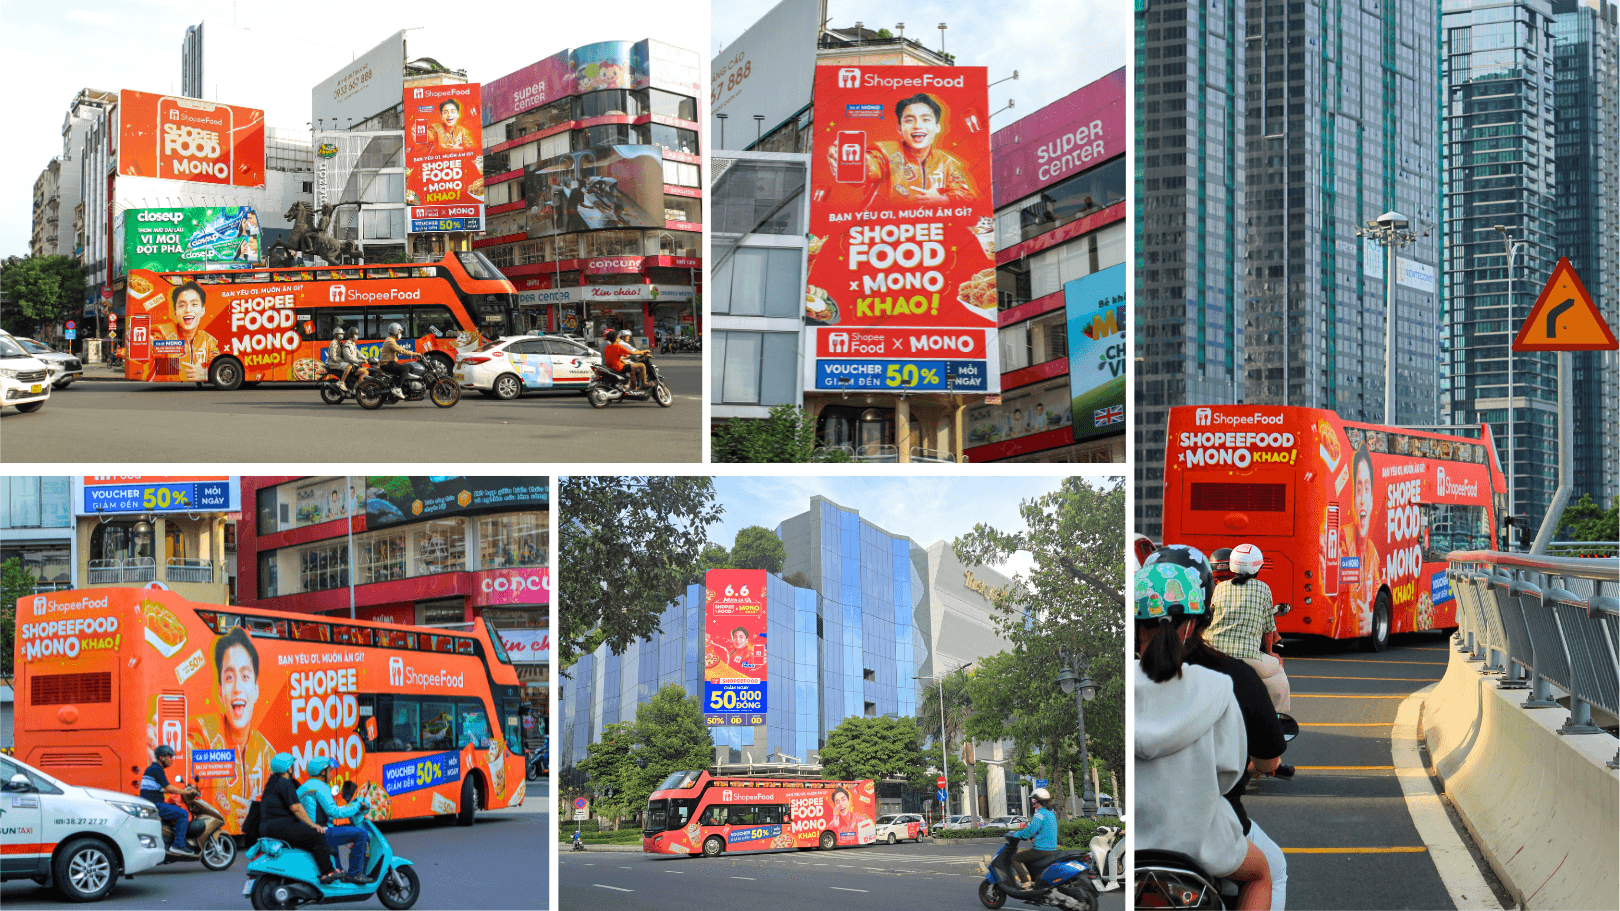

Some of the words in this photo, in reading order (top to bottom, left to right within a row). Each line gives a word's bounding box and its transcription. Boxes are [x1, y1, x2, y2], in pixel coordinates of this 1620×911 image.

[727, 60, 751, 91] 888
[864, 74, 964, 89] ShopeeFood
[425, 88, 470, 98] ShopeeFood
[181, 113, 222, 126] ShopeeFood
[164, 123, 218, 143] SHOPEE
[164, 133, 220, 158] FOOD
[172, 159, 228, 178] MONO
[422, 160, 462, 171] SHOPEE
[422, 168, 462, 182] FOOD
[428, 181, 462, 192] MONO
[426, 190, 460, 202] KHAO!
[829, 213, 852, 223] BẠN
[855, 210, 877, 220] YÊU
[899, 207, 931, 219] MUỐN
[936, 208, 952, 217] ĂN
[954, 206, 972, 216] GÌ?
[440, 220, 461, 229] 50%
[849, 223, 944, 244] SHOPEE
[849, 242, 946, 270] FOOD
[862, 271, 944, 295] MONO
[348, 289, 420, 302] ShopeeFood
[1098, 296, 1110, 308] Bé
[231, 294, 294, 313] SHOPEE
[857, 293, 940, 317] KHAO!
[232, 310, 294, 332] FOOD
[232, 330, 299, 356] MONO
[852, 333, 884, 343] Shopee
[910, 335, 974, 352] MONO
[852, 342, 884, 353] Food
[244, 352, 286, 366] KHAO!
[824, 364, 882, 374] VOUCHER
[885, 364, 939, 387] 50%
[858, 376, 880, 386] ĐẾN
[955, 376, 982, 386] NGÀY
[1213, 413, 1283, 426] ShopeeFood
[1180, 432, 1294, 447] SHOPEEFOOD
[1186, 448, 1251, 468] MONO
[1253, 449, 1298, 465] KHAO!
[92, 490, 140, 499] VOUCHER
[1388, 478, 1421, 508] SHOPEE
[1446, 476, 1477, 500] ShopeeFood
[120, 499, 138, 508] ĐẾN
[143, 487, 188, 508] 50%
[202, 496, 224, 505] NGÀY
[1387, 504, 1420, 544] FOOD
[1386, 544, 1422, 586] MONO
[725, 584, 749, 596] 6.6
[1393, 580, 1415, 604] KHAO!
[48, 596, 108, 613] ShopeeFood
[22, 616, 118, 639] SHOPEEFOOD
[26, 637, 80, 661] MONO
[81, 633, 121, 651] KHAO!
[278, 655, 293, 666] BẠN
[295, 654, 309, 665] YÊU
[322, 650, 342, 662] MUỐN
[290, 668, 357, 697] SHOPEE
[406, 666, 464, 690] ShopeeFood
[291, 694, 358, 734] FOOD
[210, 752, 232, 761] MONO
[292, 734, 363, 779] MONO
[386, 765, 415, 780] VOUCHER
[416, 760, 442, 786] 50%
[734, 793, 774, 802] ShopeeFood
[791, 797, 824, 807] SHOPEE
[791, 806, 824, 819] FOOD
[792, 819, 826, 833] MONO
[751, 829, 769, 839] 50%
[798, 831, 820, 839] KHAO!
